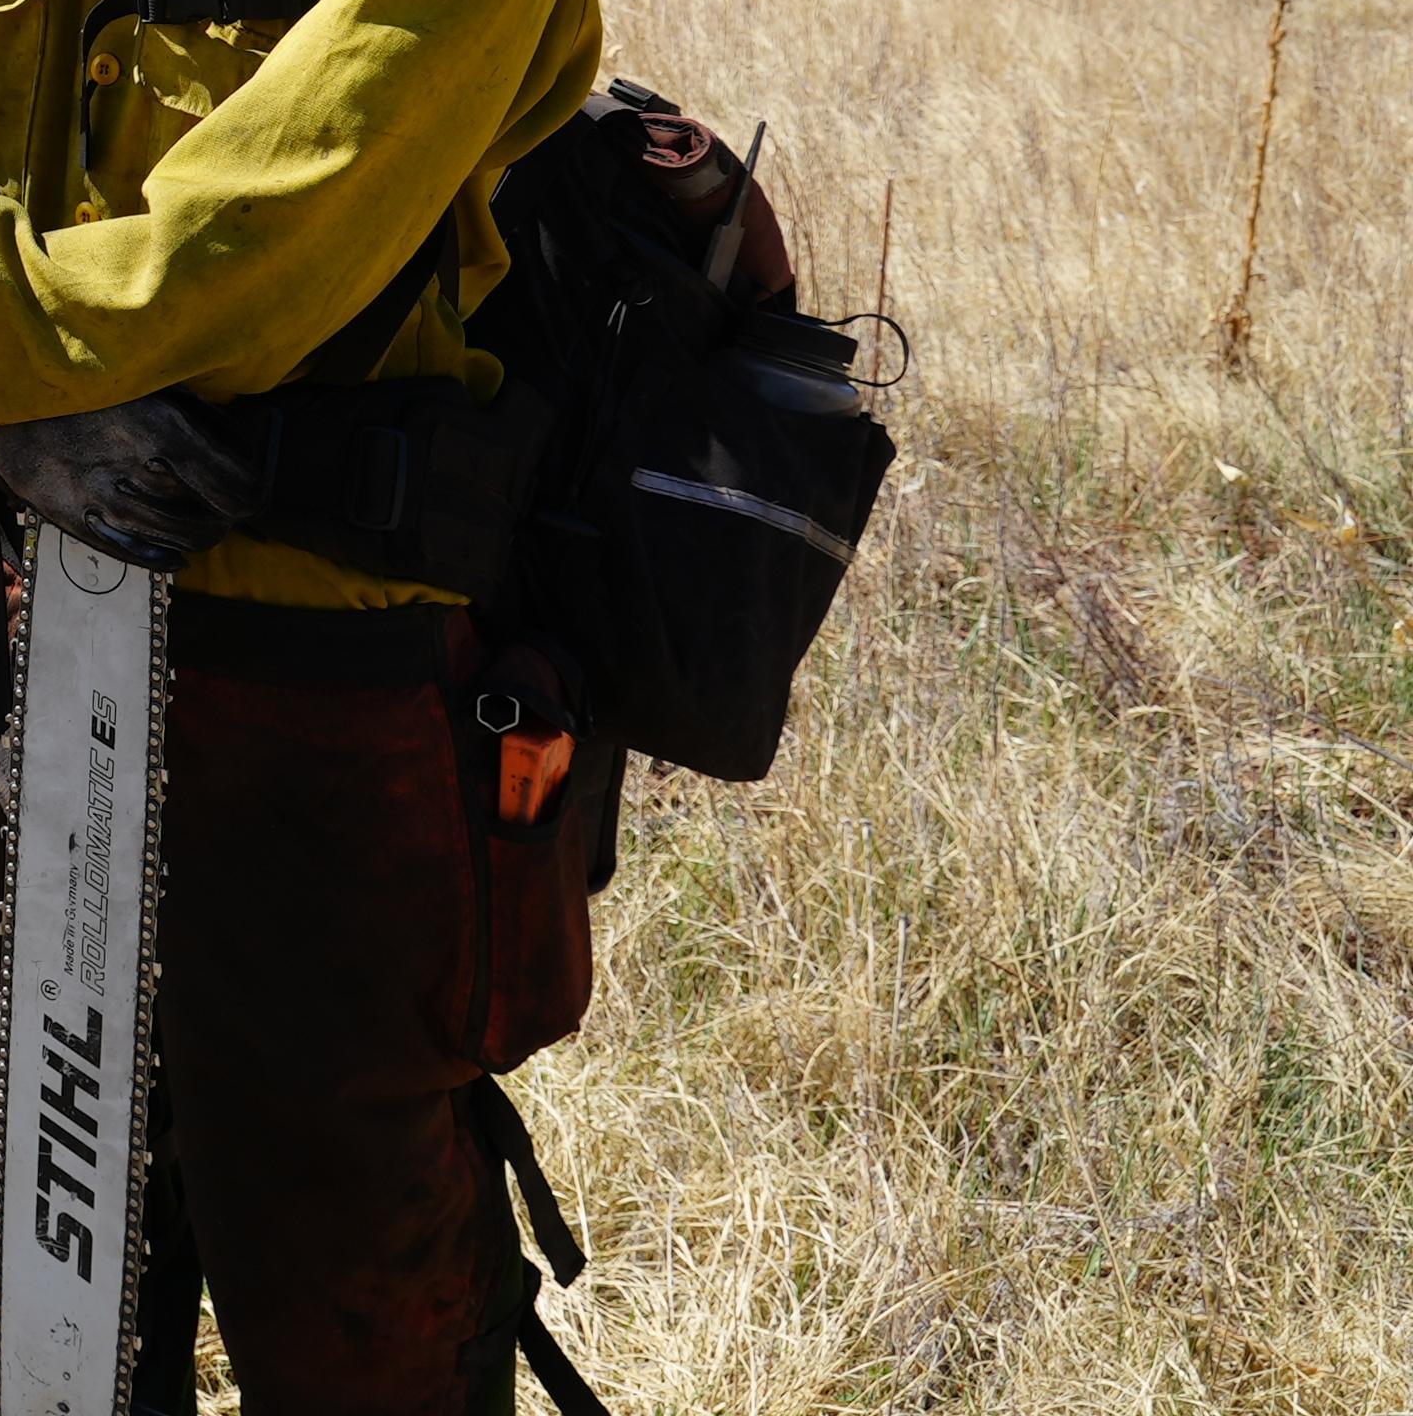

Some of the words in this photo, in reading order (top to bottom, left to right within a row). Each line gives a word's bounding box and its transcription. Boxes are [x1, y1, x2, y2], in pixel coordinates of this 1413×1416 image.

[91, 689, 117, 750] ES
[80, 747, 115, 996] ROLLOMATIC
[62, 939, 76, 976] Made
